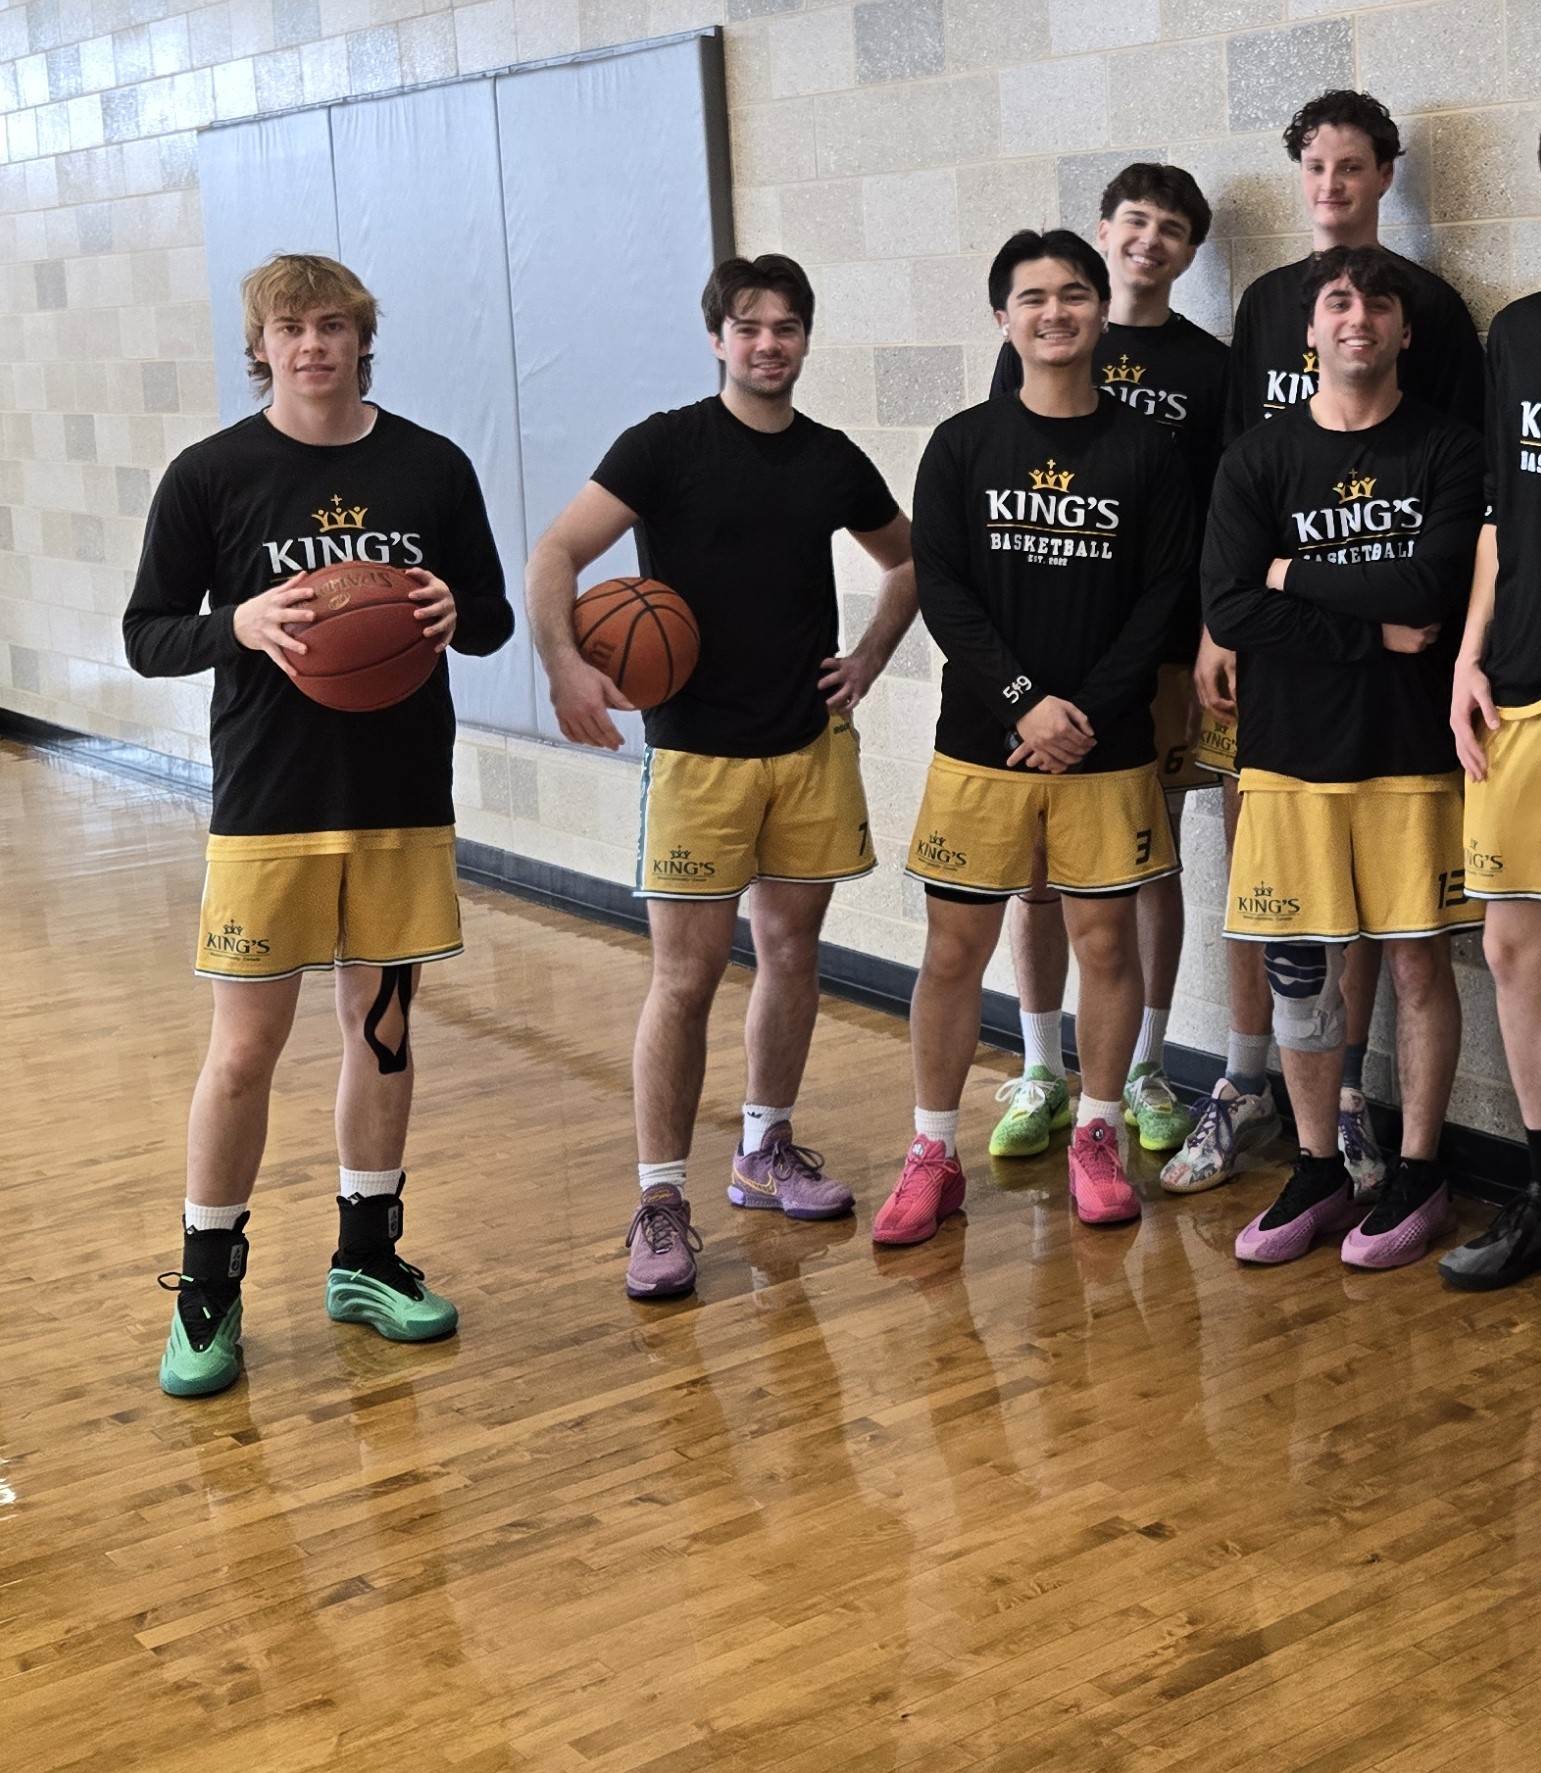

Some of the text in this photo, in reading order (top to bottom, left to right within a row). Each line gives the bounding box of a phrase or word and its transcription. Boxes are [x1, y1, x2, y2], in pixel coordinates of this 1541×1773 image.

[1267, 370, 1315, 404] KIN
[985, 489, 1120, 530] KING'S
[1291, 497, 1423, 543] KING'S
[262, 531, 424, 574] KING'S
[990, 532, 1113, 559] BASKETBALL
[917, 839, 967, 866] KING'S
[1135, 829, 1151, 865] 3
[652, 859, 716, 876] KING'S
[1237, 896, 1301, 914] KING'S
[206, 932, 271, 954] KING'S
